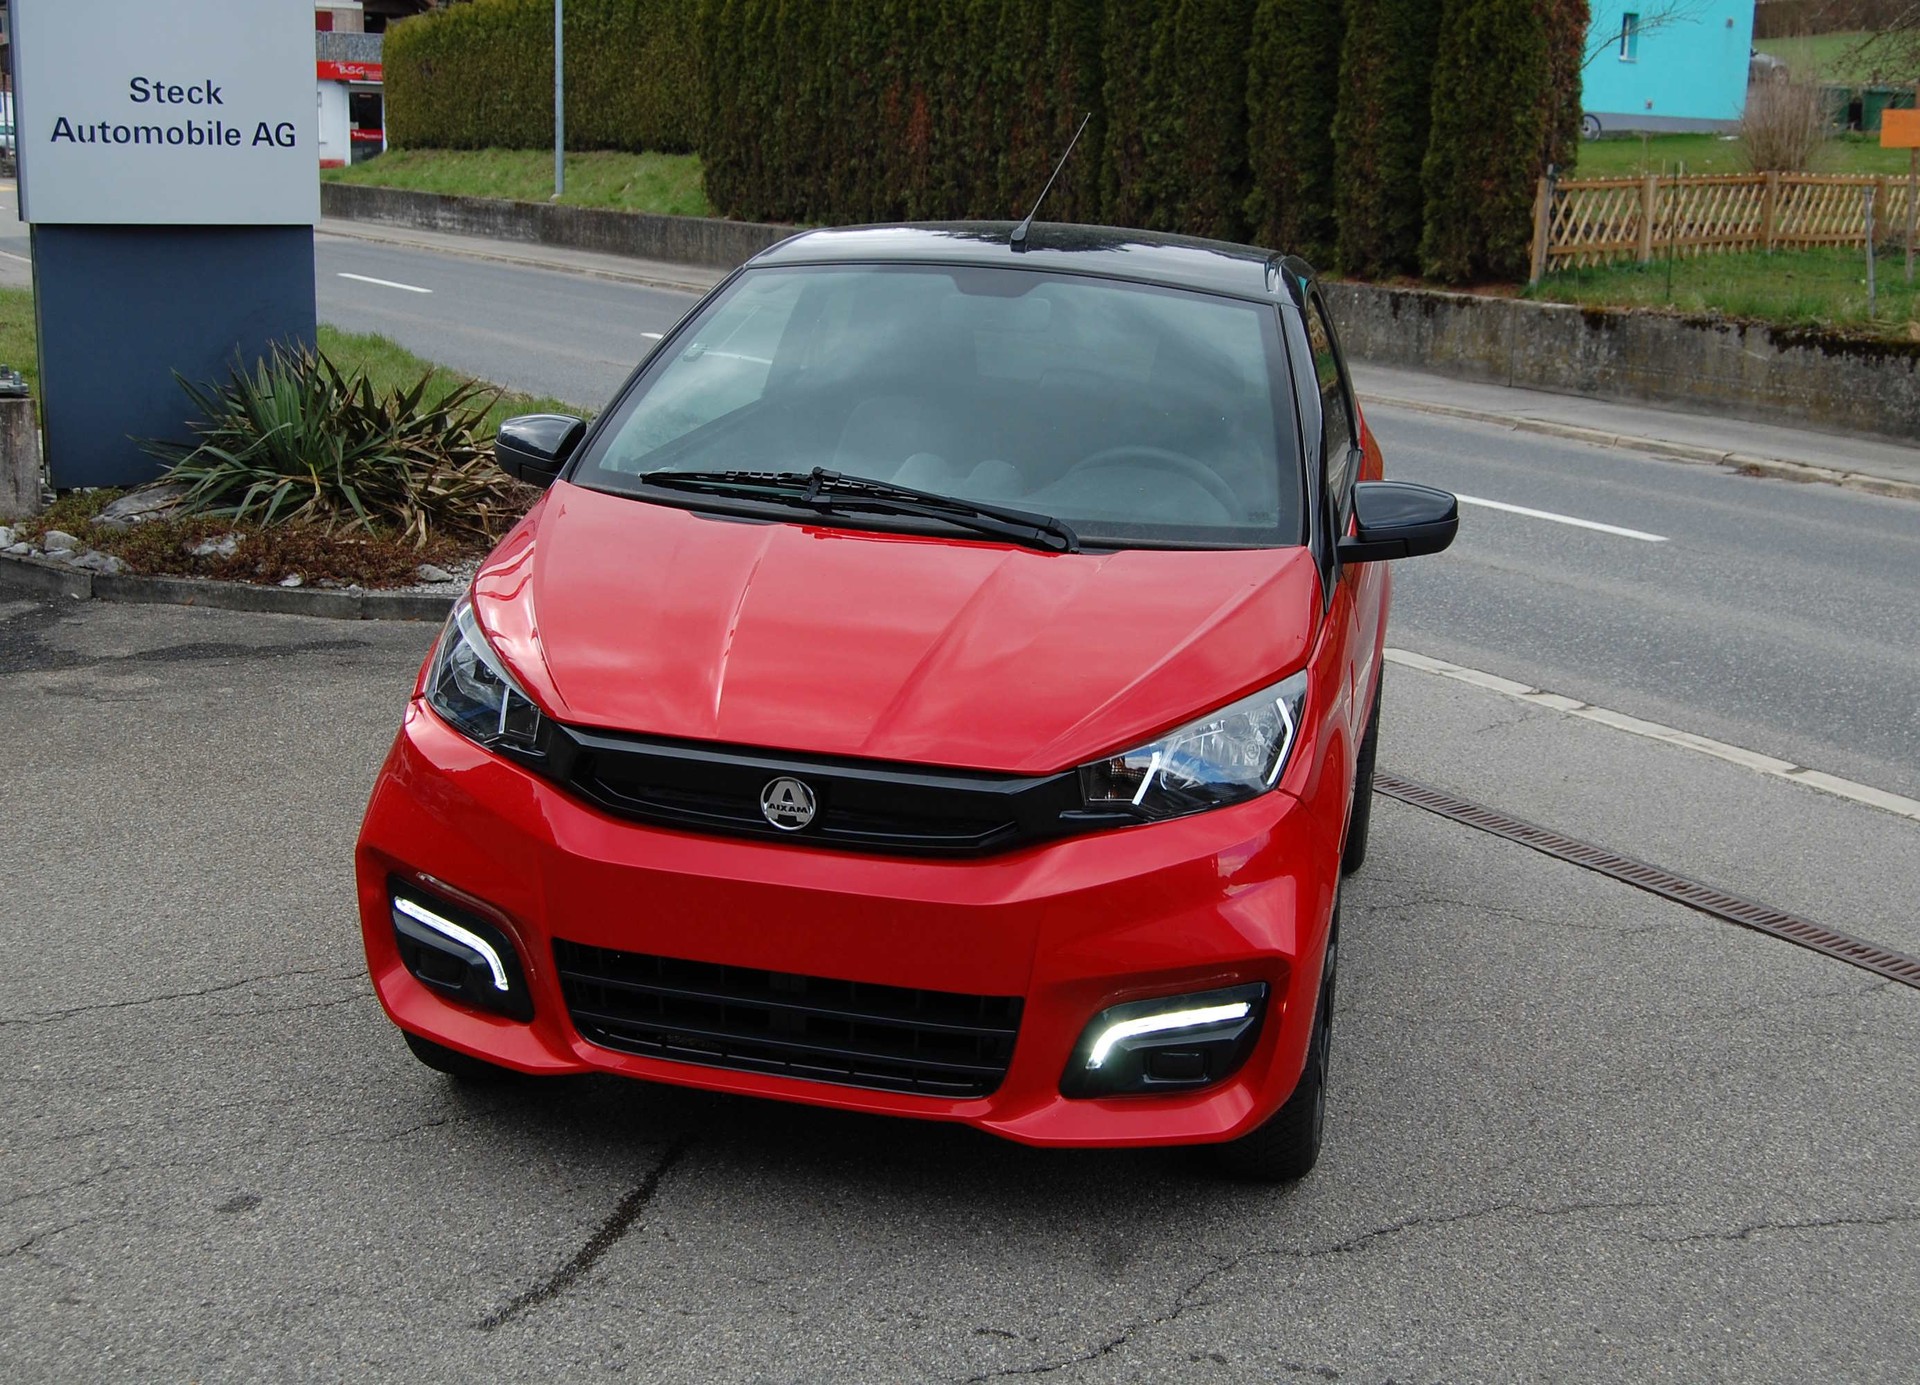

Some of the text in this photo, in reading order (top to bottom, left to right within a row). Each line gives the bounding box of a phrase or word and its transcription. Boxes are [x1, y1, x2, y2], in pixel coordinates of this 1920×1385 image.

[129, 76, 224, 105] Steck
[50, 116, 296, 148] Automobile AG
[768, 803, 808, 814] AIXAM
